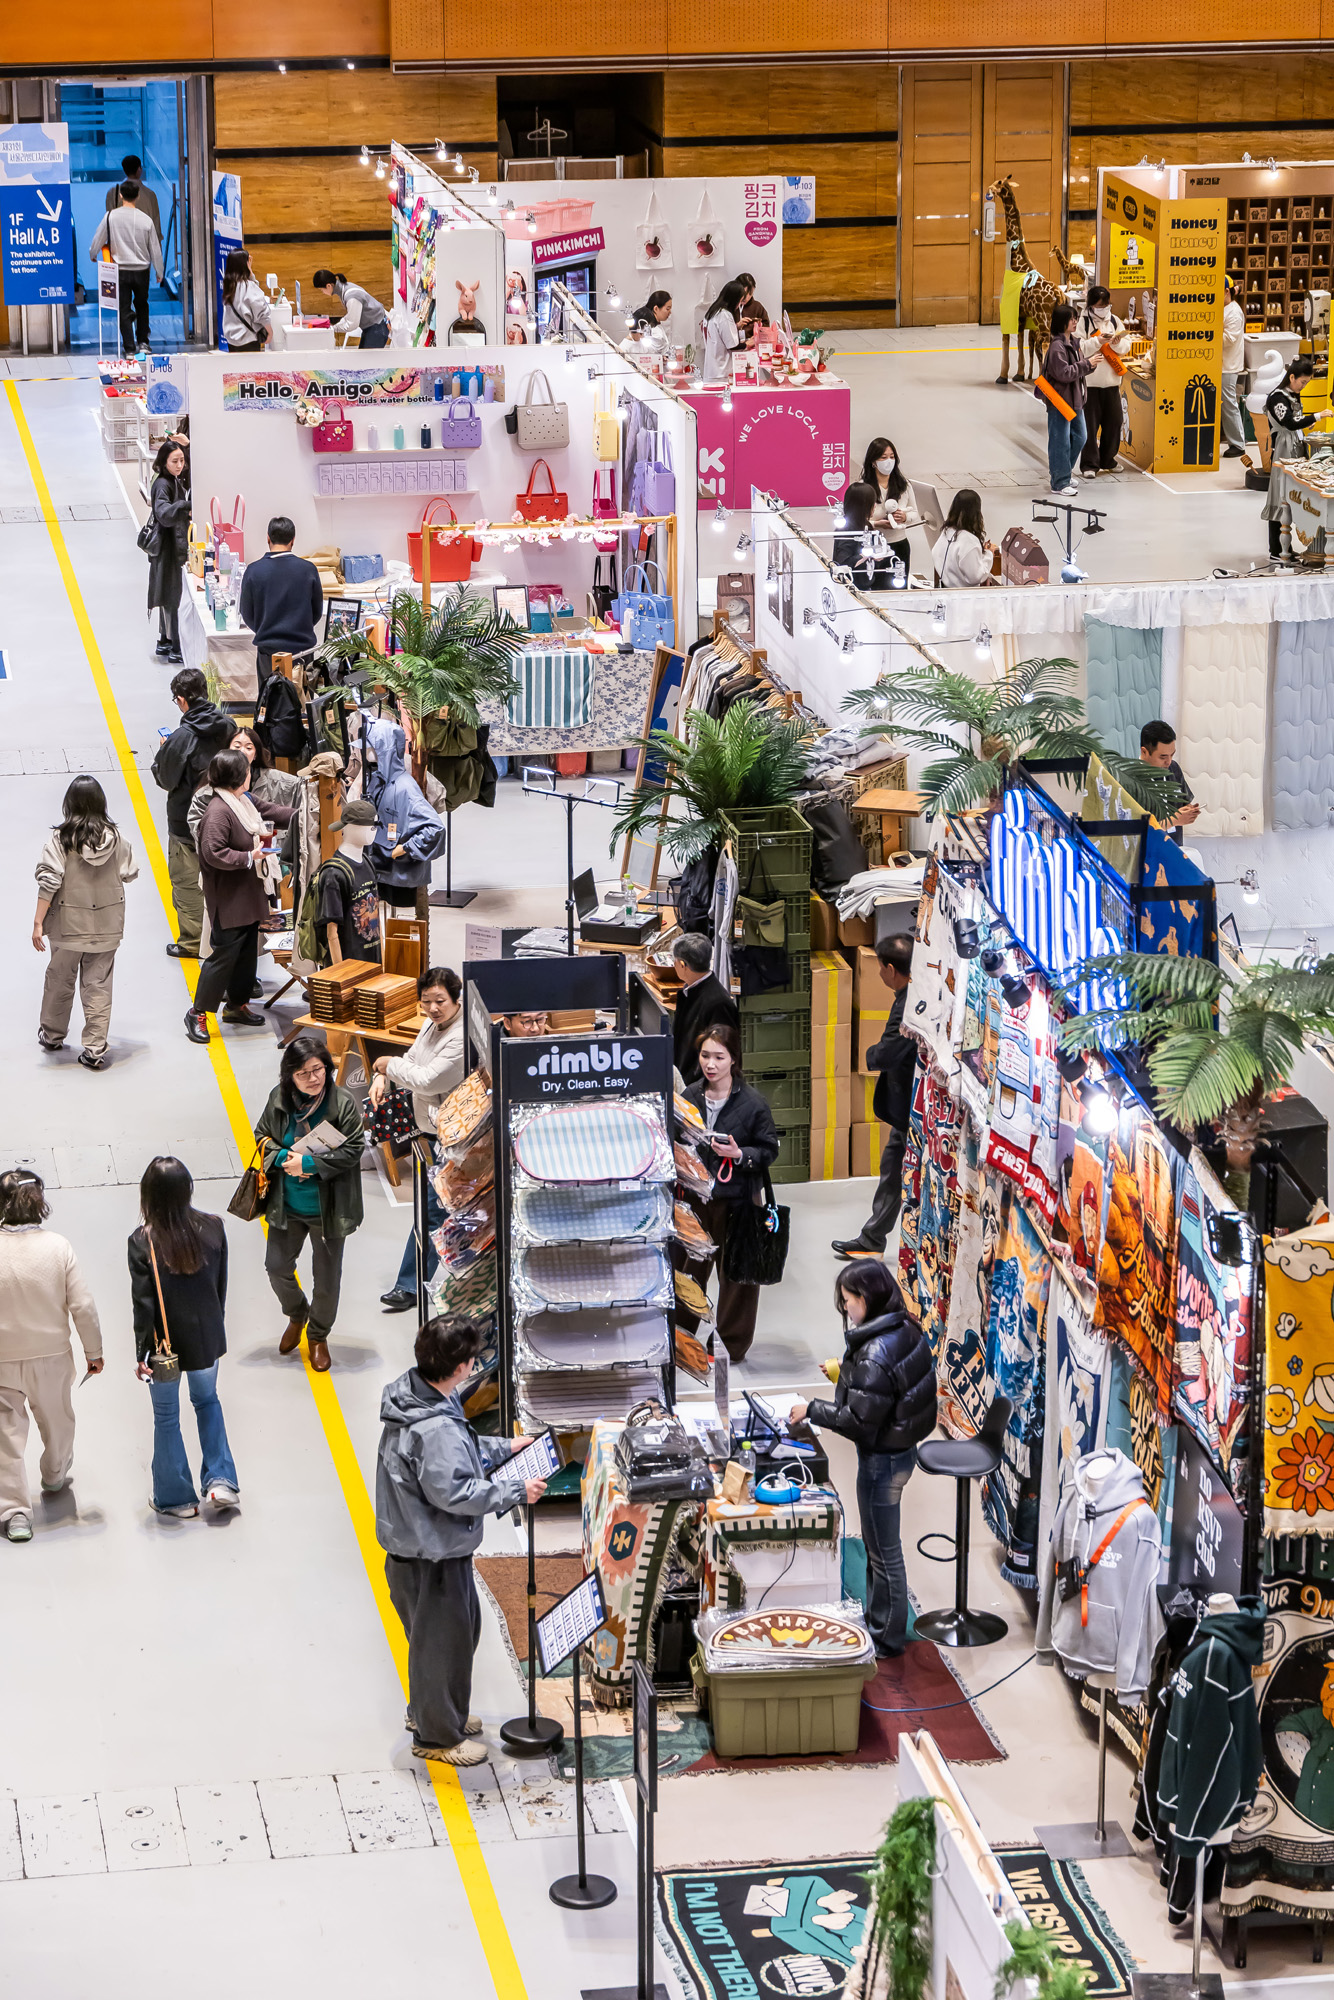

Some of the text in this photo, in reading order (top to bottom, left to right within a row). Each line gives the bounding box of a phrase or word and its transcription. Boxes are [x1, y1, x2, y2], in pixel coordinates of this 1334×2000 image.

[744, 183, 776, 199] 핑크
[745, 201, 775, 218] 김치
[1144, 204, 1156, 221] Honey
[9, 213, 24, 226] 1F
[1171, 218, 1217, 230] Honey
[9, 227, 60, 246] Hall A, B
[1170, 237, 1217, 250] Honey
[1170, 256, 1216, 267] Honey
[1169, 274, 1216, 287] Honey
[1169, 293, 1215, 305] Honey
[1168, 311, 1215, 324] Honey
[1168, 330, 1214, 342] Honey
[1167, 348, 1214, 361] Honey
[239, 379, 374, 400] Hello, Amigo
[407, 395, 433, 403] bottle
[738, 405, 820, 443] WE LOVE LOCAL
[823, 443, 845, 456] 핑크
[823, 456, 845, 469] 김치
[542, 1076, 633, 1093] Dry. Clean. Easy.
[1199, 1466, 1212, 1502] no
[1197, 1492, 1223, 1552] RSVP
[1196, 1530, 1216, 1578] club
[1007, 1867, 1051, 1902] WE
[685, 1882, 763, 2000] I'M NOT THER
